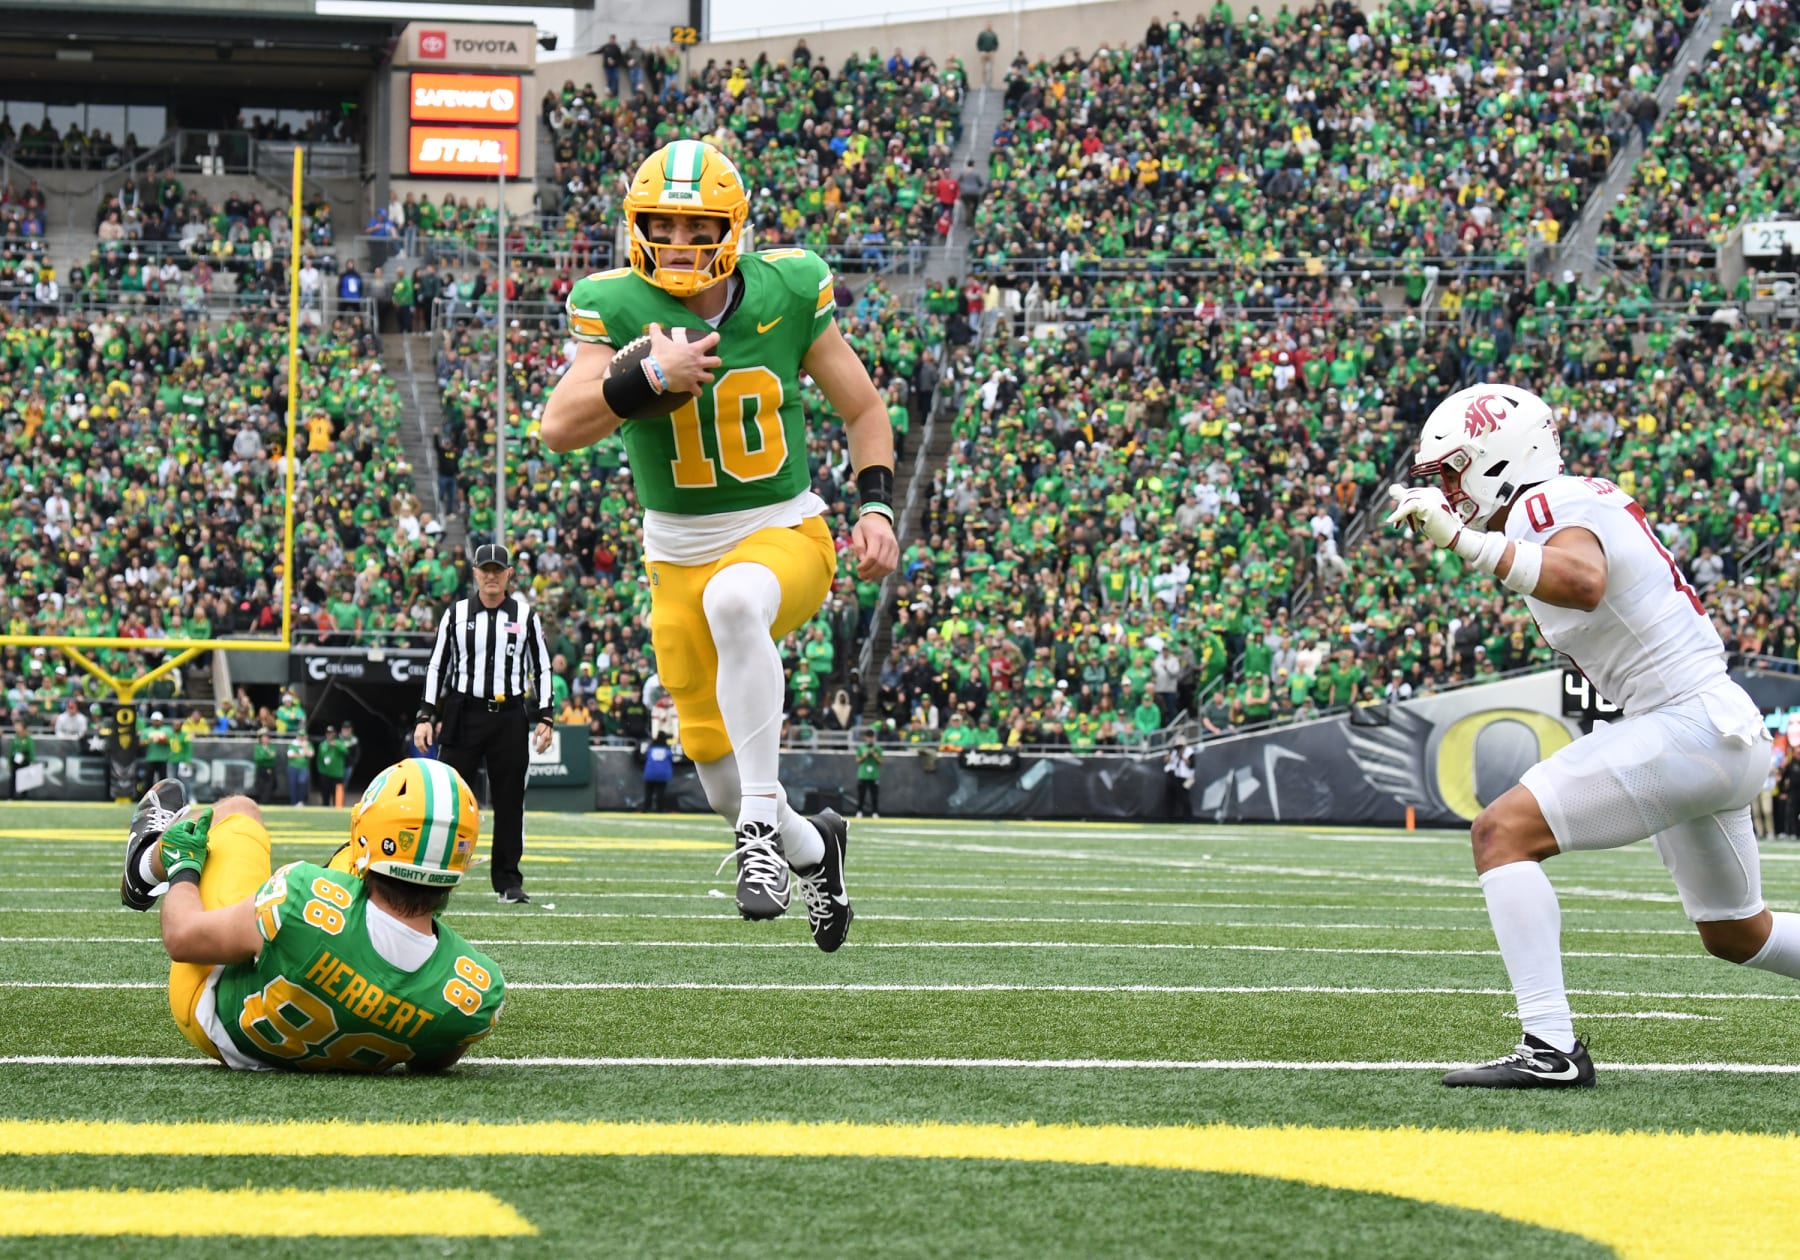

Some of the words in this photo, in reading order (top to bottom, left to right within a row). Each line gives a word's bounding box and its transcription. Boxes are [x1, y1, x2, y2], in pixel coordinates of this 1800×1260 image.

[453, 38, 517, 52] TOYOTA
[673, 27, 696, 44] 22
[415, 88, 490, 108] SAFEWAY
[420, 138, 502, 162] STIHL
[1760, 230, 1784, 249] 23
[671, 366, 788, 488] 10
[1525, 493, 1555, 532] 0
[507, 643, 515, 656] C
[325, 664, 364, 677] CELSIUS
[528, 765, 568, 776] OYOTA
[383, 840, 395, 849] 64
[389, 865, 427, 881] MIGHTY
[427, 873, 460, 884] OREGON
[303, 877, 352, 935] 88
[304, 951, 434, 1038] HERBERT
[443, 956, 491, 1015] 88
